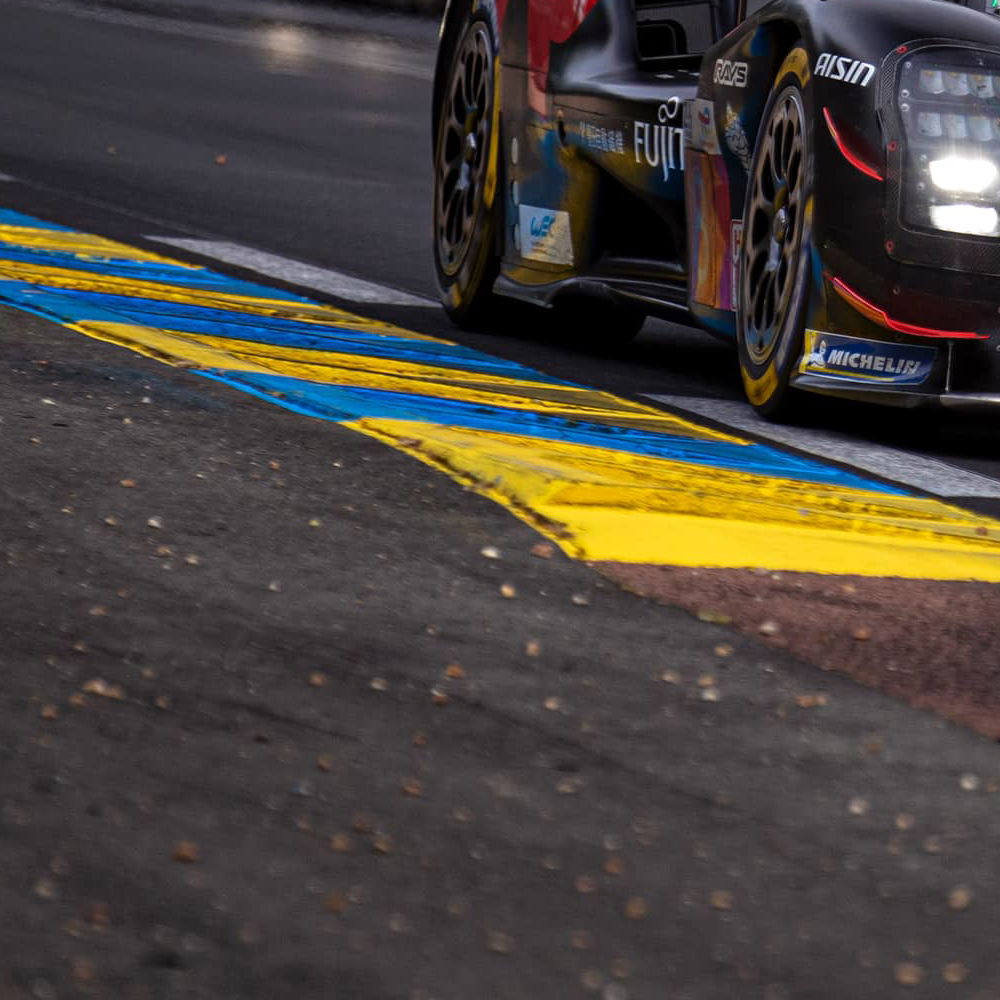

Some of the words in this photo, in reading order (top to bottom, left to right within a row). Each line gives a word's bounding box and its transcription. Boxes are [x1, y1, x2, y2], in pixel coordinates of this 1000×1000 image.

[713, 58, 748, 88] RAYS
[813, 53, 876, 87] AISIN
[827, 349, 921, 376] MICHELIN
